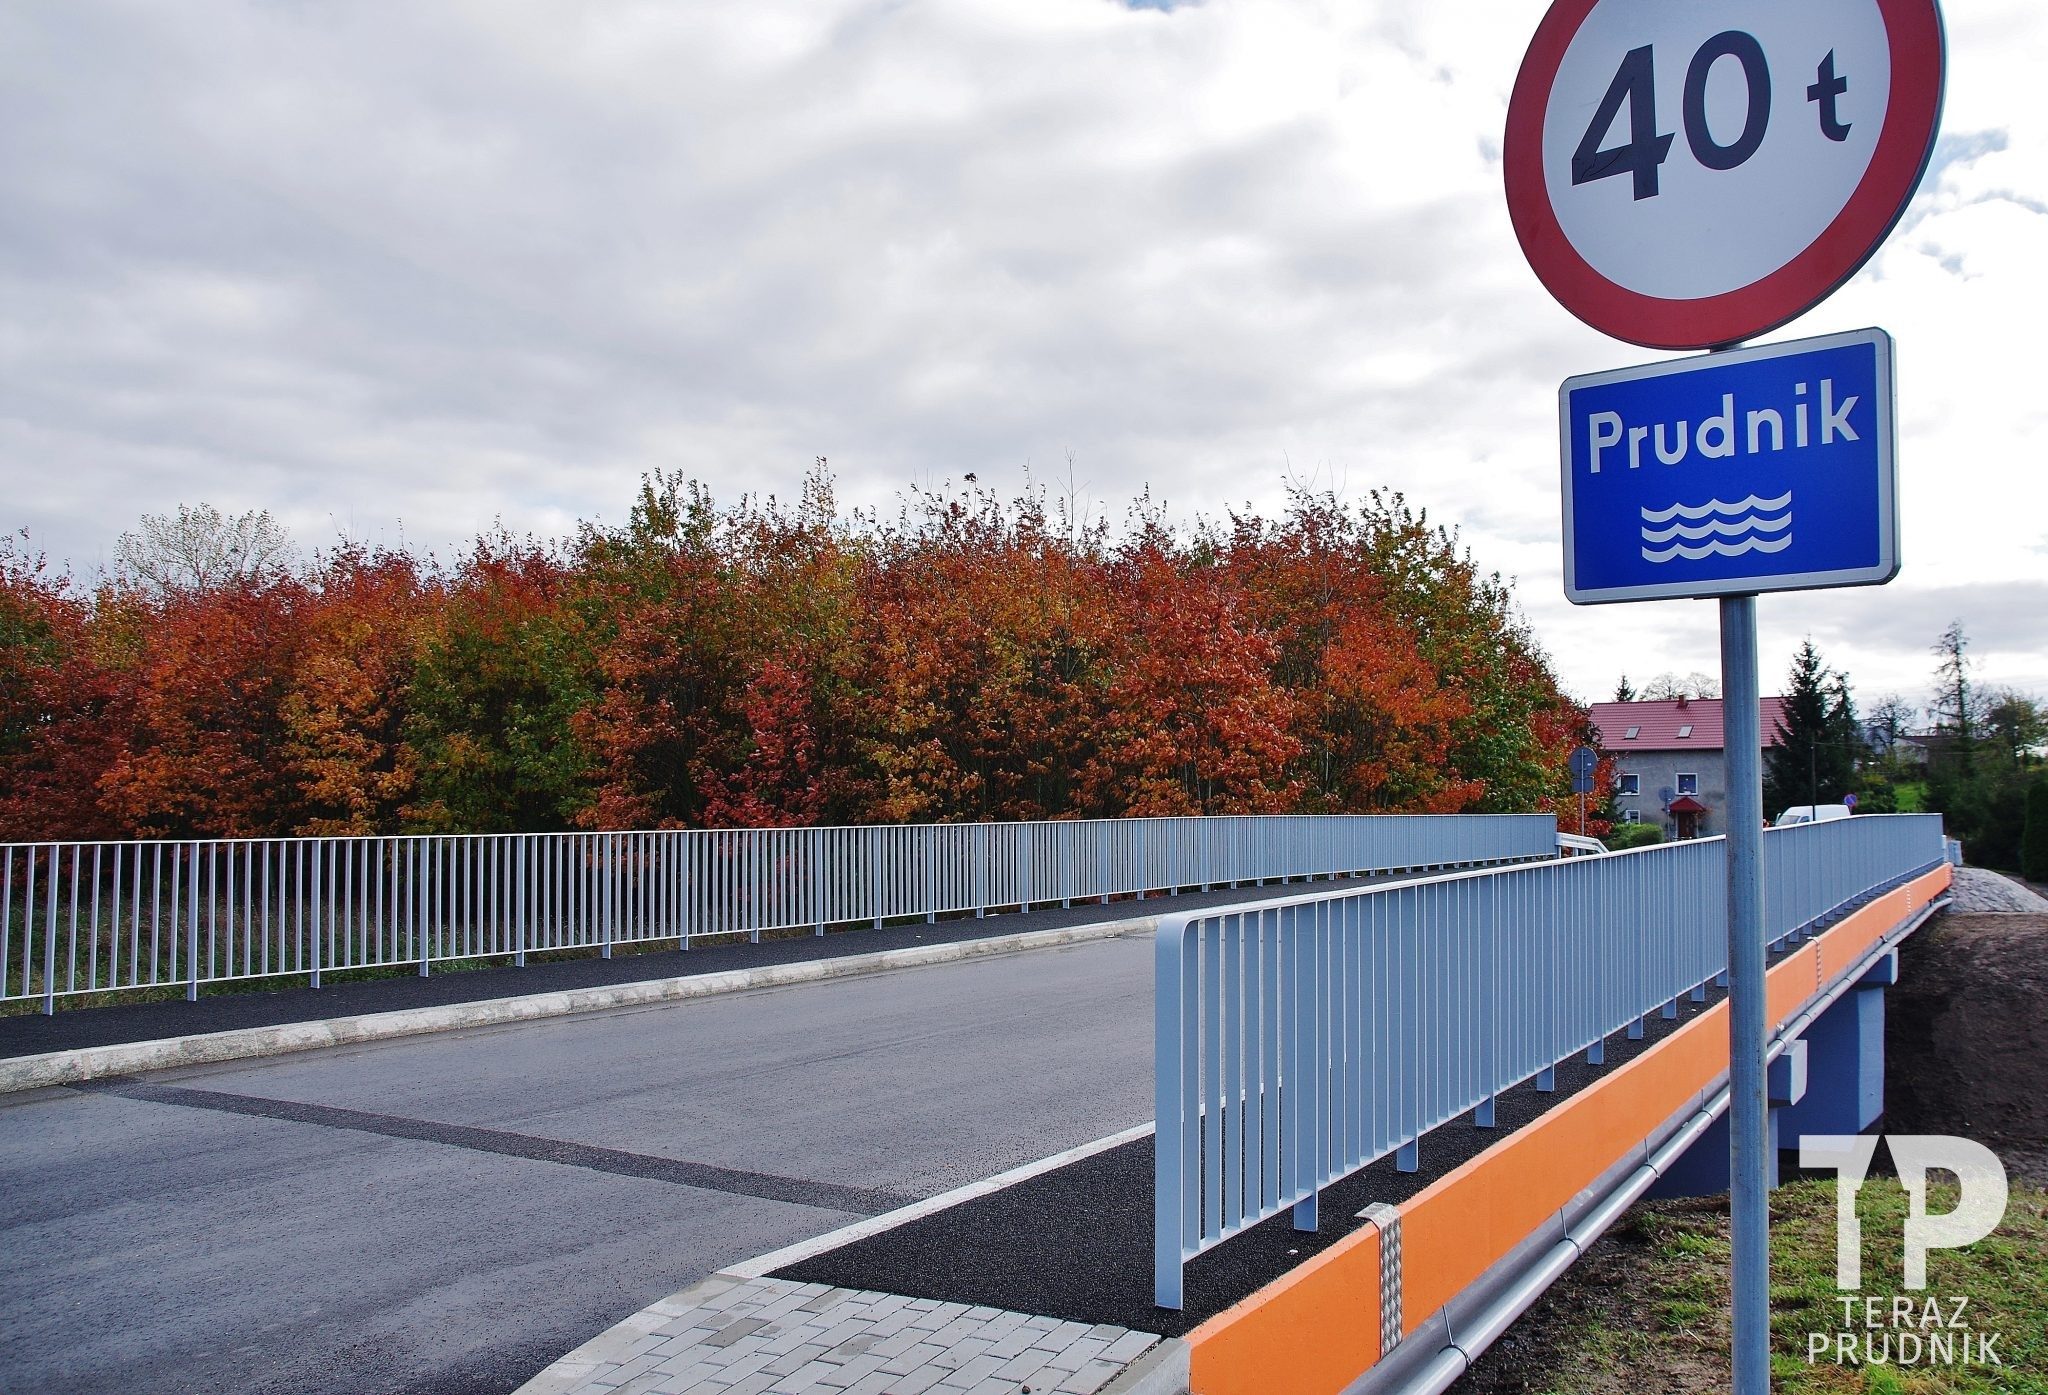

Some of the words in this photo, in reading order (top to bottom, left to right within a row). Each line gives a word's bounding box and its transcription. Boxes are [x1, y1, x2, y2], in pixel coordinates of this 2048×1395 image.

[1572, 30, 1772, 201] 40
[1807, 48, 1853, 142] t
[1589, 379, 1860, 473] Prudnik
